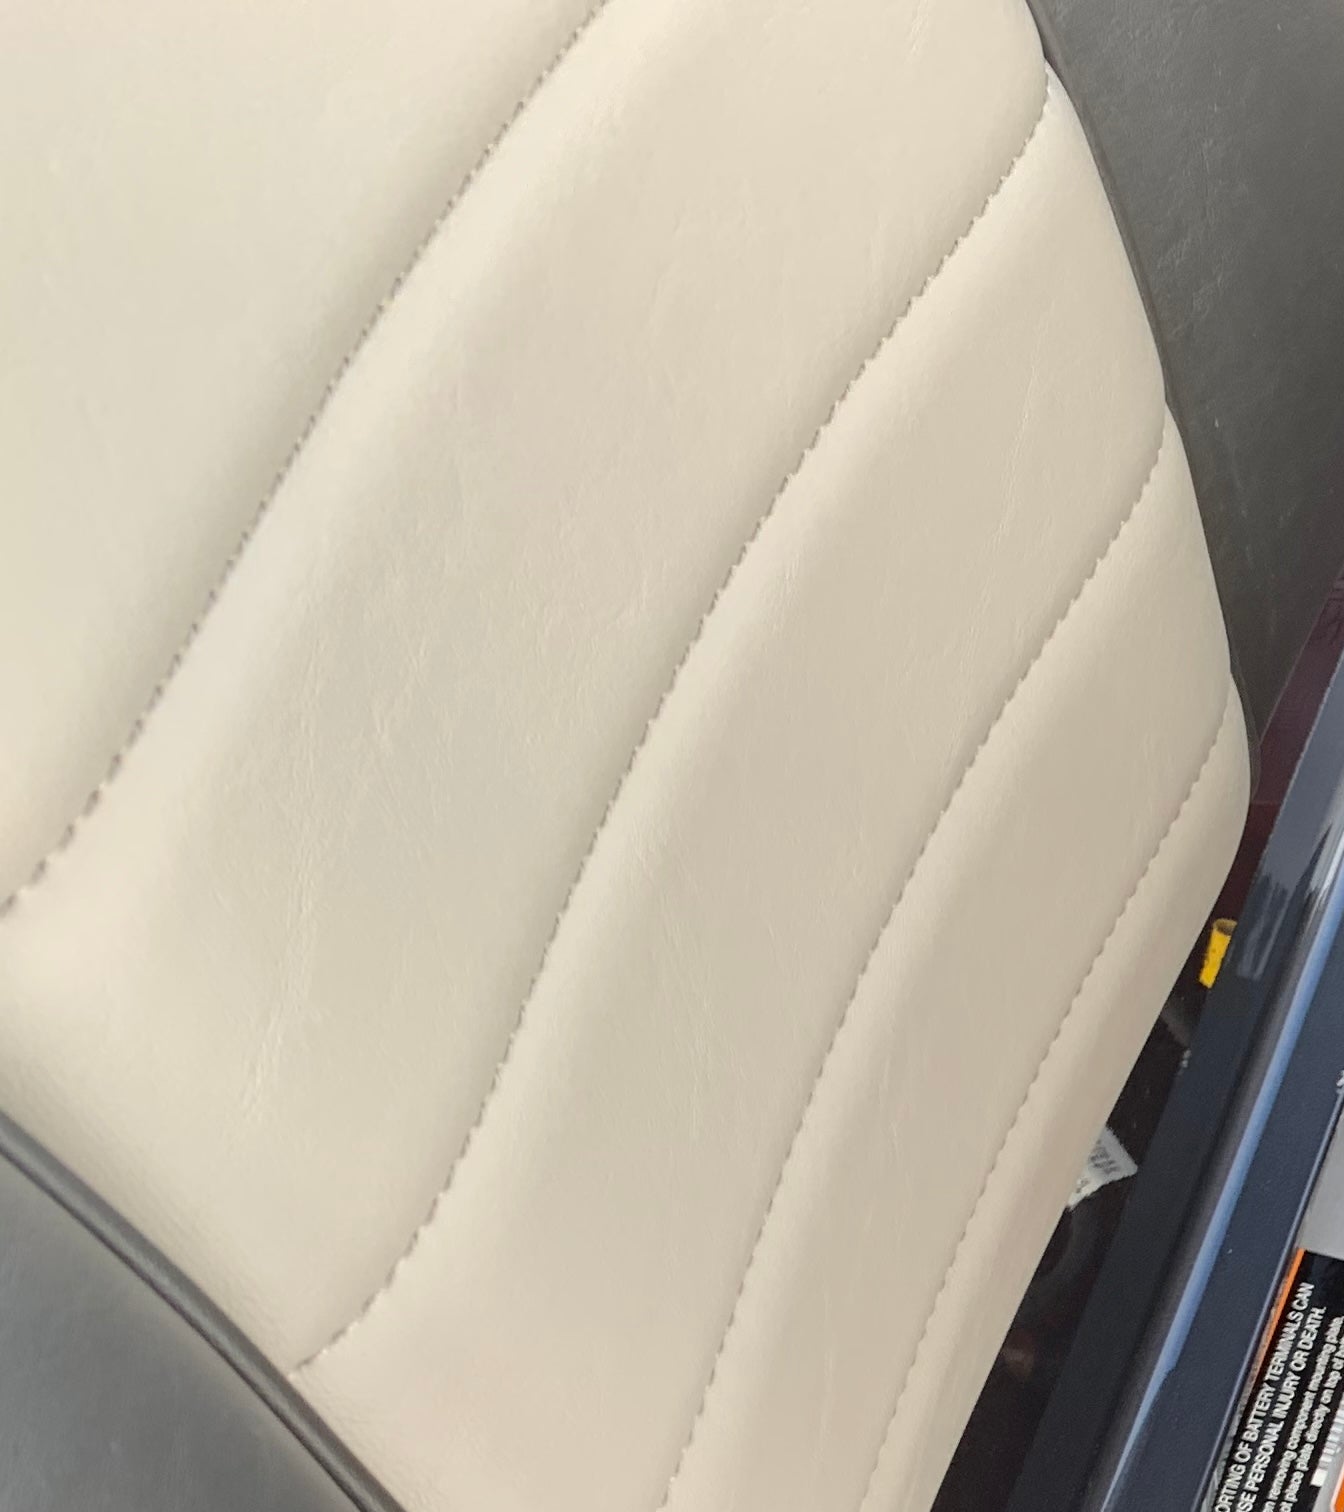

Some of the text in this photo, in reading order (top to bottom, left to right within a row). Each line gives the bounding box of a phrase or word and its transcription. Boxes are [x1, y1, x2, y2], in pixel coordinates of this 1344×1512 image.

[1290, 1348, 1310, 1369] OR
[1298, 1304, 1325, 1349] DEATH.
[1232, 1441, 1254, 1463] OF
[1243, 1382, 1275, 1441] BATTERY
[1266, 1310, 1302, 1381] TERMINALS
[1291, 1281, 1315, 1311] CAN
[1272, 1371, 1300, 1418] INJURY
[1246, 1419, 1282, 1491] PERSONAL
[1268, 1450, 1296, 1500] removing
[1286, 1392, 1317, 1450] component
[1308, 1342, 1334, 1391] mounting
[1284, 1470, 1305, 1501] place
[1296, 1443, 1314, 1469] plate
[1305, 1404, 1329, 1442] directly
